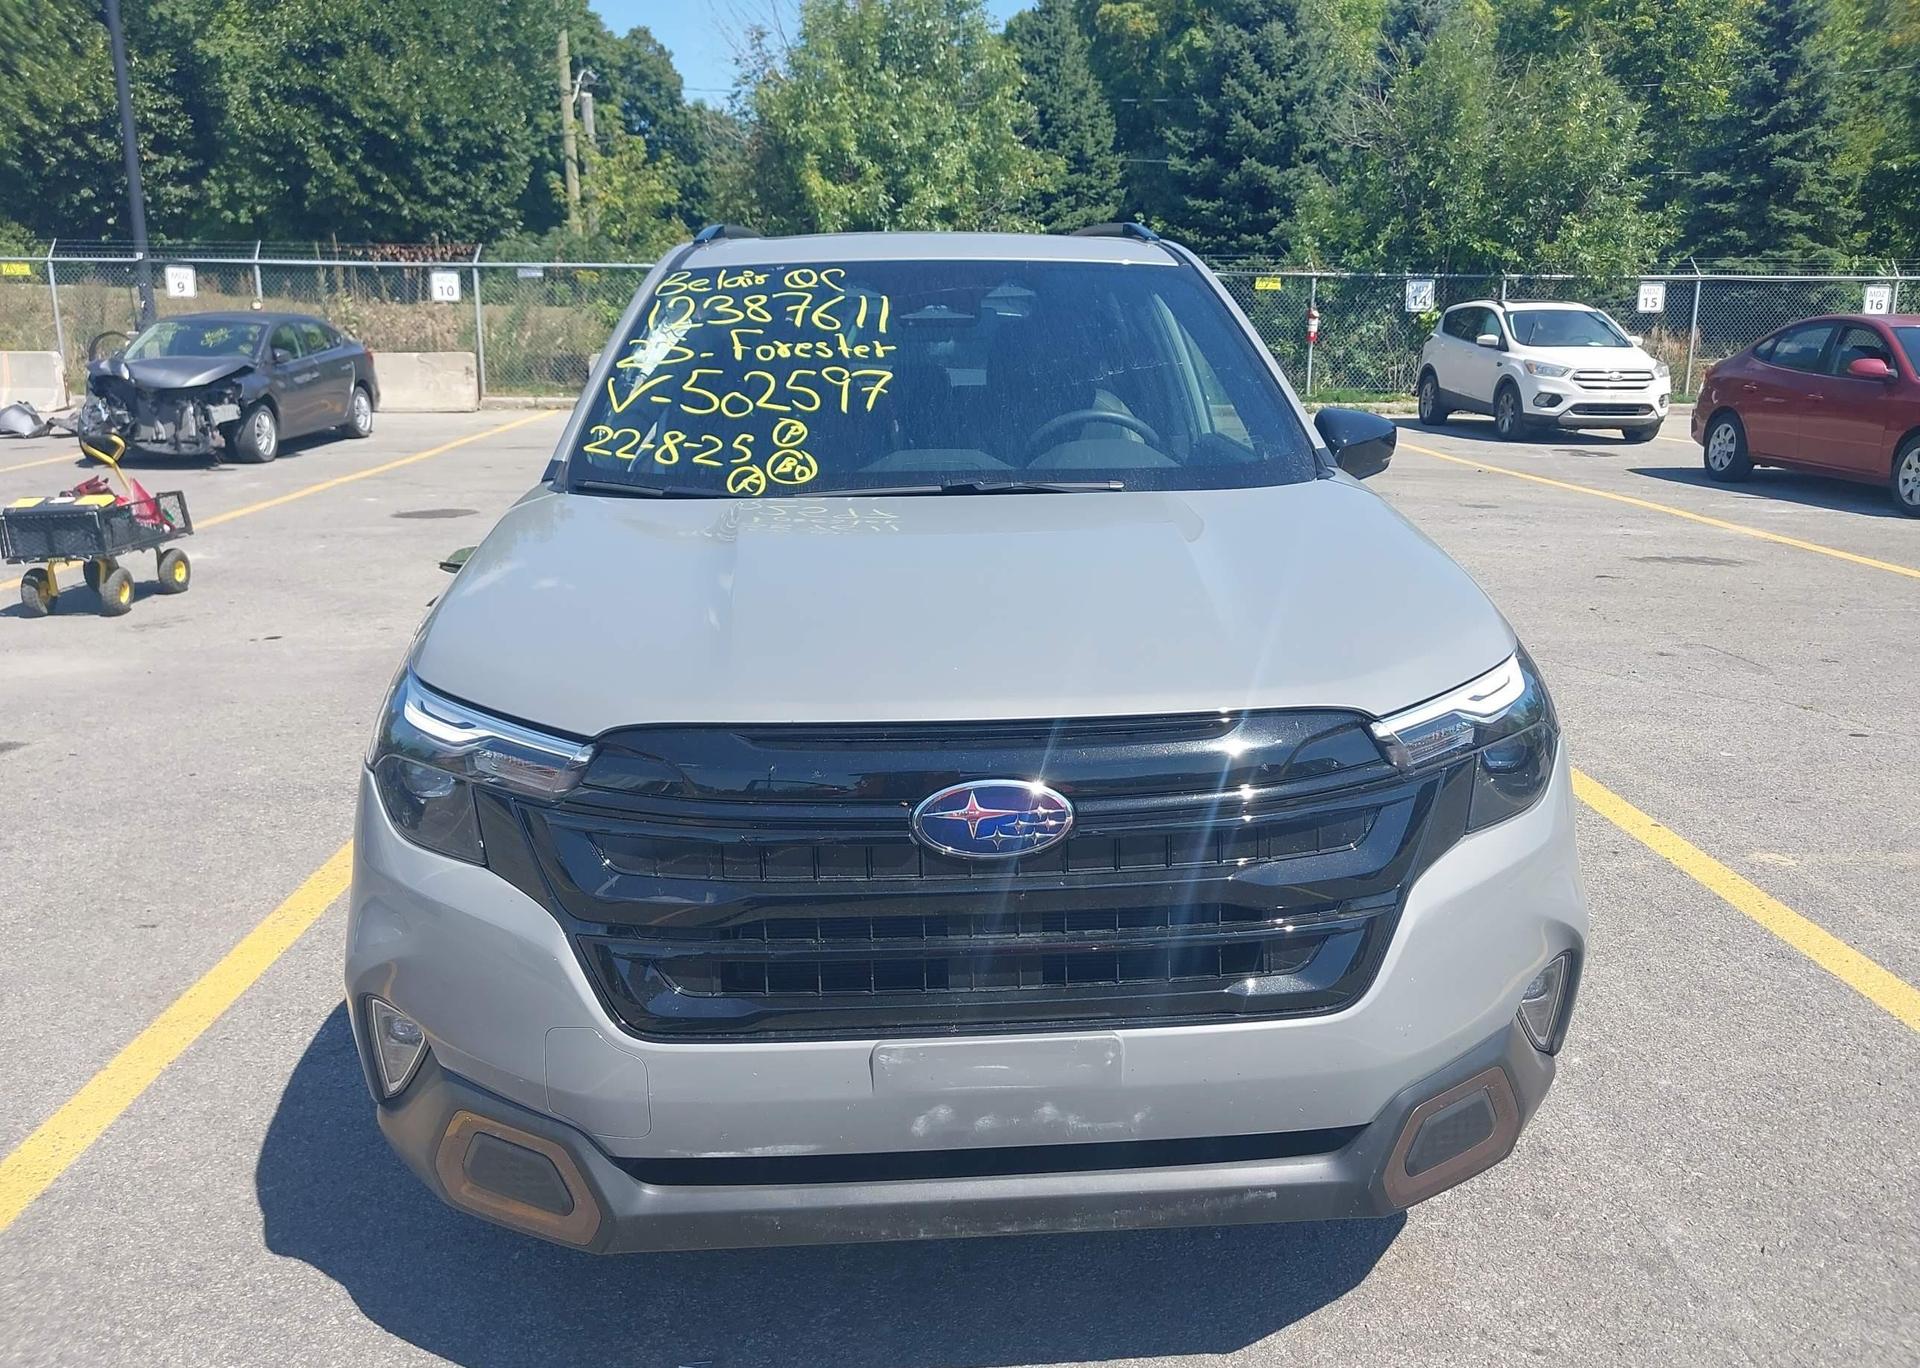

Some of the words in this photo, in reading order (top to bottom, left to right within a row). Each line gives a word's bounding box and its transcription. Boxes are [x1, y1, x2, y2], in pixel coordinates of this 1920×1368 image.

[177, 281, 185, 293] 9
[439, 285, 455, 297] 10
[1411, 295, 1428, 307] 14
[1643, 297, 1658, 308] 15
[1869, 299, 1884, 310] 16
[647, 292, 890, 334] 12387611
[730, 328, 898, 362] Forester
